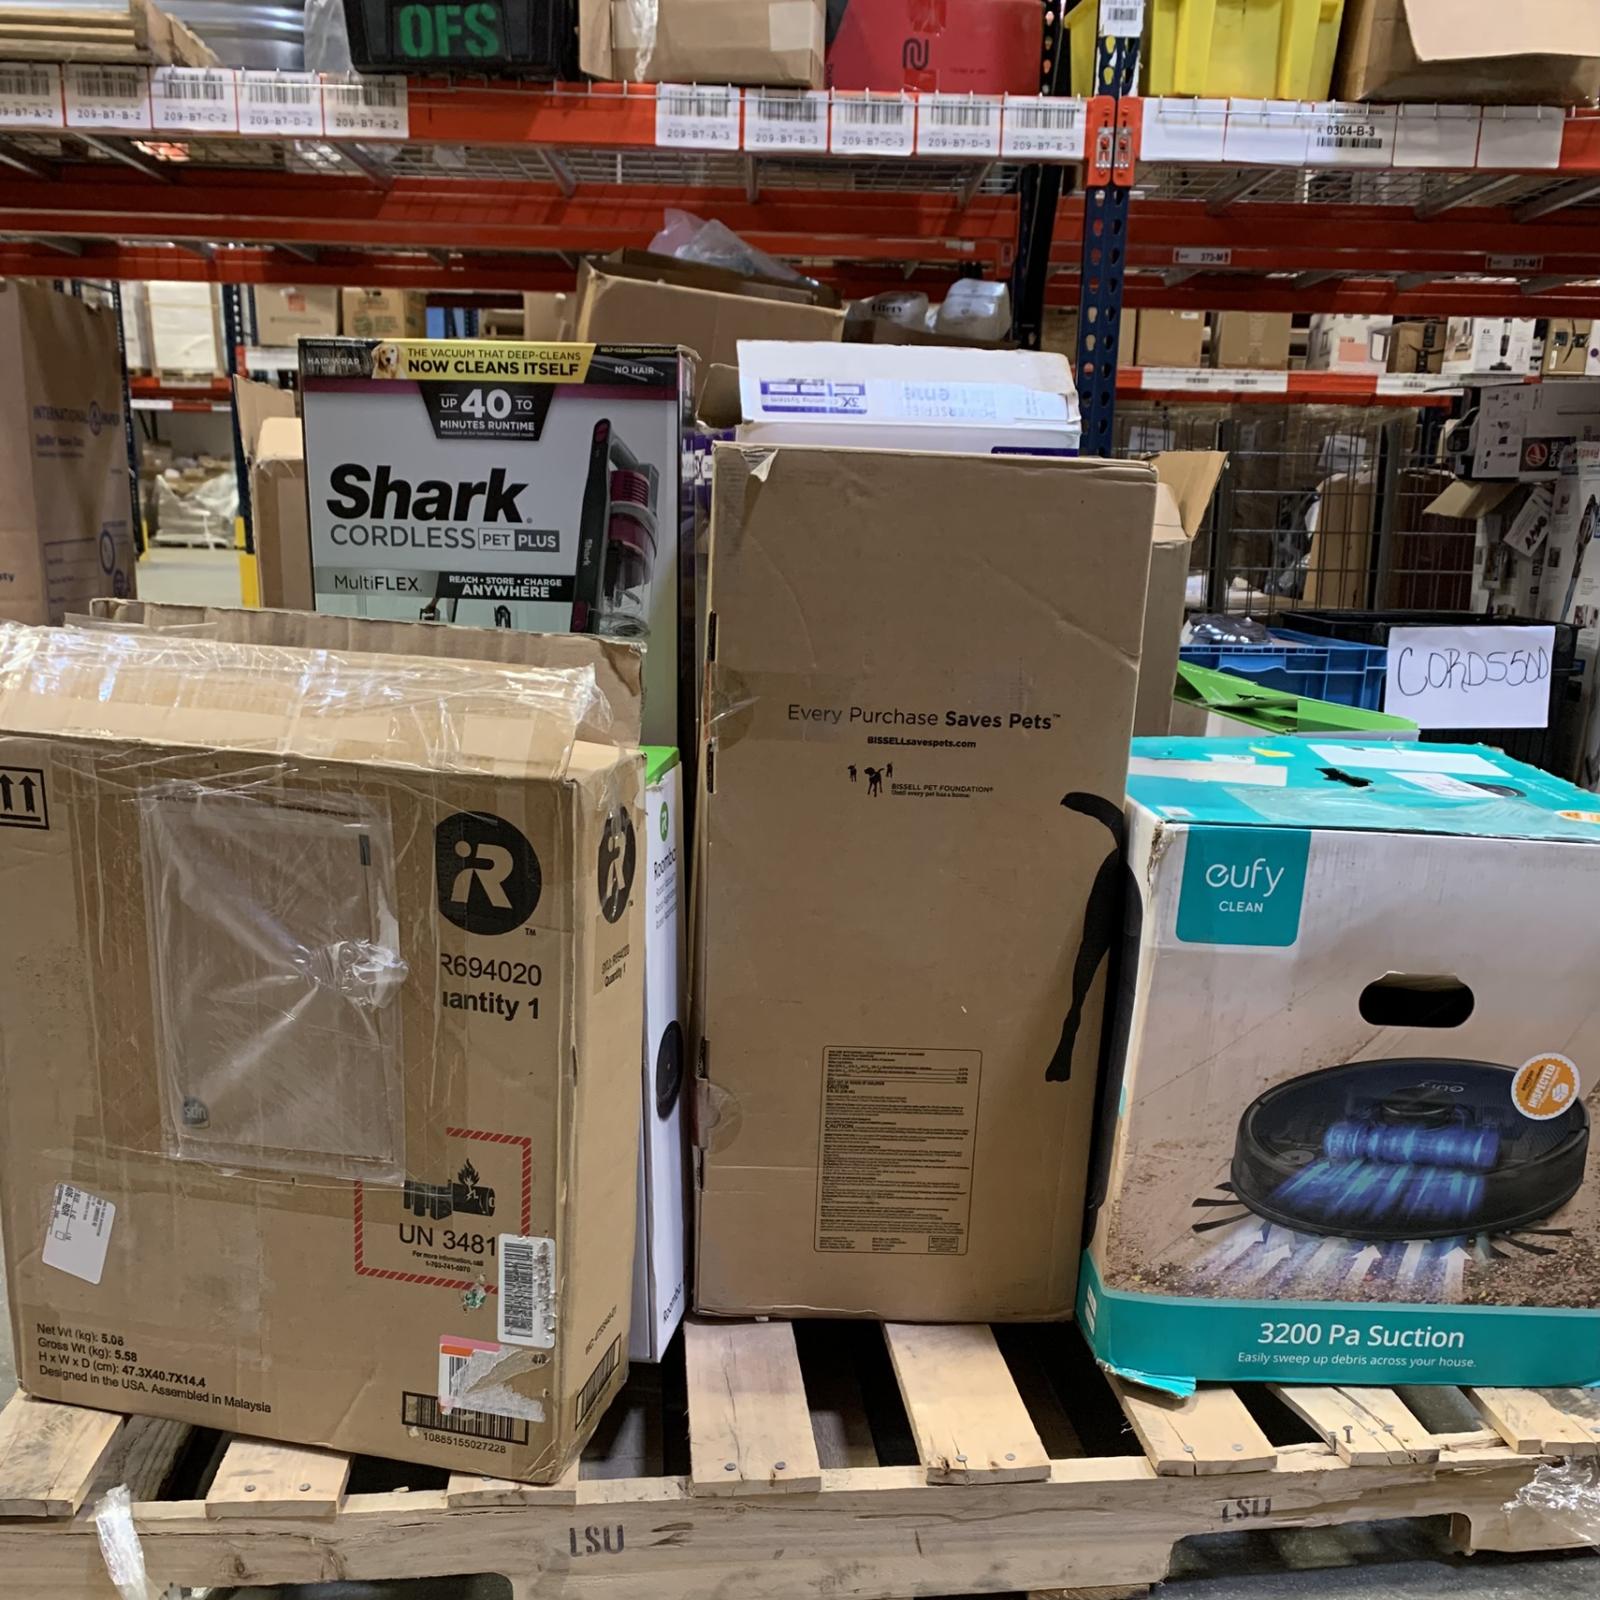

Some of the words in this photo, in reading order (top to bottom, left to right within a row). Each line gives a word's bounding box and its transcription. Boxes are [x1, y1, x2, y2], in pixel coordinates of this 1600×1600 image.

[401, 4, 500, 58] OFS
[0, 108, 53, 118] 9-B7-A-2
[667, 128, 731, 140] 209-B7-A-3
[1327, 125, 1376, 137] 0304-B-3
[928, 137, 991, 149] 209-B7-D-3
[1012, 140, 1076, 151] 209-B7-E-3
[407, 348, 428, 357] THE
[430, 348, 476, 359] VACUUM
[479, 350, 505, 359] THAT
[507, 350, 581, 361] DEEP-CLEANS
[408, 360, 449, 374] NOW
[453, 361, 519, 375] CLEANS
[524, 363, 579, 376] ITSELF
[614, 366, 630, 374] NO
[631, 366, 655, 375] HAIR
[441, 398, 458, 408] UP
[460, 388, 513, 419] 40
[515, 399, 533, 410] TO
[440, 419, 486, 430] MINUTES
[488, 421, 535, 431] RUNTIME
[326, 462, 529, 524] Shark
[330, 524, 475, 550] CORDLESS
[482, 533, 511, 547] PET
[518, 534, 556, 548] PLUS
[334, 575, 420, 592] MultiFLEX
[449, 575, 479, 584] REACH
[486, 576, 515, 585] STORE
[523, 578, 562, 587] CHARGE
[462, 585, 550, 598] ANYWHERE
[788, 704, 842, 725] Every
[850, 706, 938, 726] Purchase
[945, 711, 1002, 728] Saves
[867, 735, 977, 748] BISSELLsavespets.com
[891, 783, 921, 791] BISSELL
[1205, 858, 1285, 898] eufy
[1218, 900, 1264, 913] CLEAN
[440, 953, 543, 987] R694020
[442, 991, 520, 1021] antity
[528, 997, 539, 1019] 1
[399, 1223, 434, 1247] UN
[442, 1230, 496, 1256] 3481
[412, 1250, 422, 1258] For
[37, 1323, 56, 1336] Net
[58, 1327, 73, 1338] Wt
[75, 1329, 98, 1344] (kg):
[1257, 1322, 1321, 1345] 3200
[1328, 1324, 1361, 1346] Pa
[1367, 1325, 1465, 1348] Suction
[38, 1337, 69, 1352] Gross
[71, 1342, 86, 1354] Wt
[88, 1344, 111, 1359] (kg):
[114, 1349, 138, 1362] 5.58
[1237, 1352, 1270, 1365] Easily
[1273, 1354, 1310, 1365] sweep
[1313, 1355, 1329, 1366] up
[1331, 1353, 1367, 1365] debris
[1370, 1356, 1407, 1366] across
[1410, 1358, 1435, 1368] your
[1439, 1357, 1477, 1368] house.
[39, 1352, 47, 1362] H
[58, 1355, 70, 1365] W
[82, 1358, 90, 1368] D
[93, 1360, 119, 1376] (cm):
[122, 1365, 206, 1388] 47.3X40.7X14.4
[40, 1365, 88, 1384] Designed
[90, 1374, 100, 1383] in
[102, 1376, 119, 1388] the
[122, 1379, 148, 1393] USA.
[151, 1383, 209, 1403] Assembled
[212, 1394, 221, 1404] in
[224, 1396, 272, 1413] Malaysia
[423, 1432, 507, 1454] 10885155027228
[569, 1524, 625, 1557] LSU
